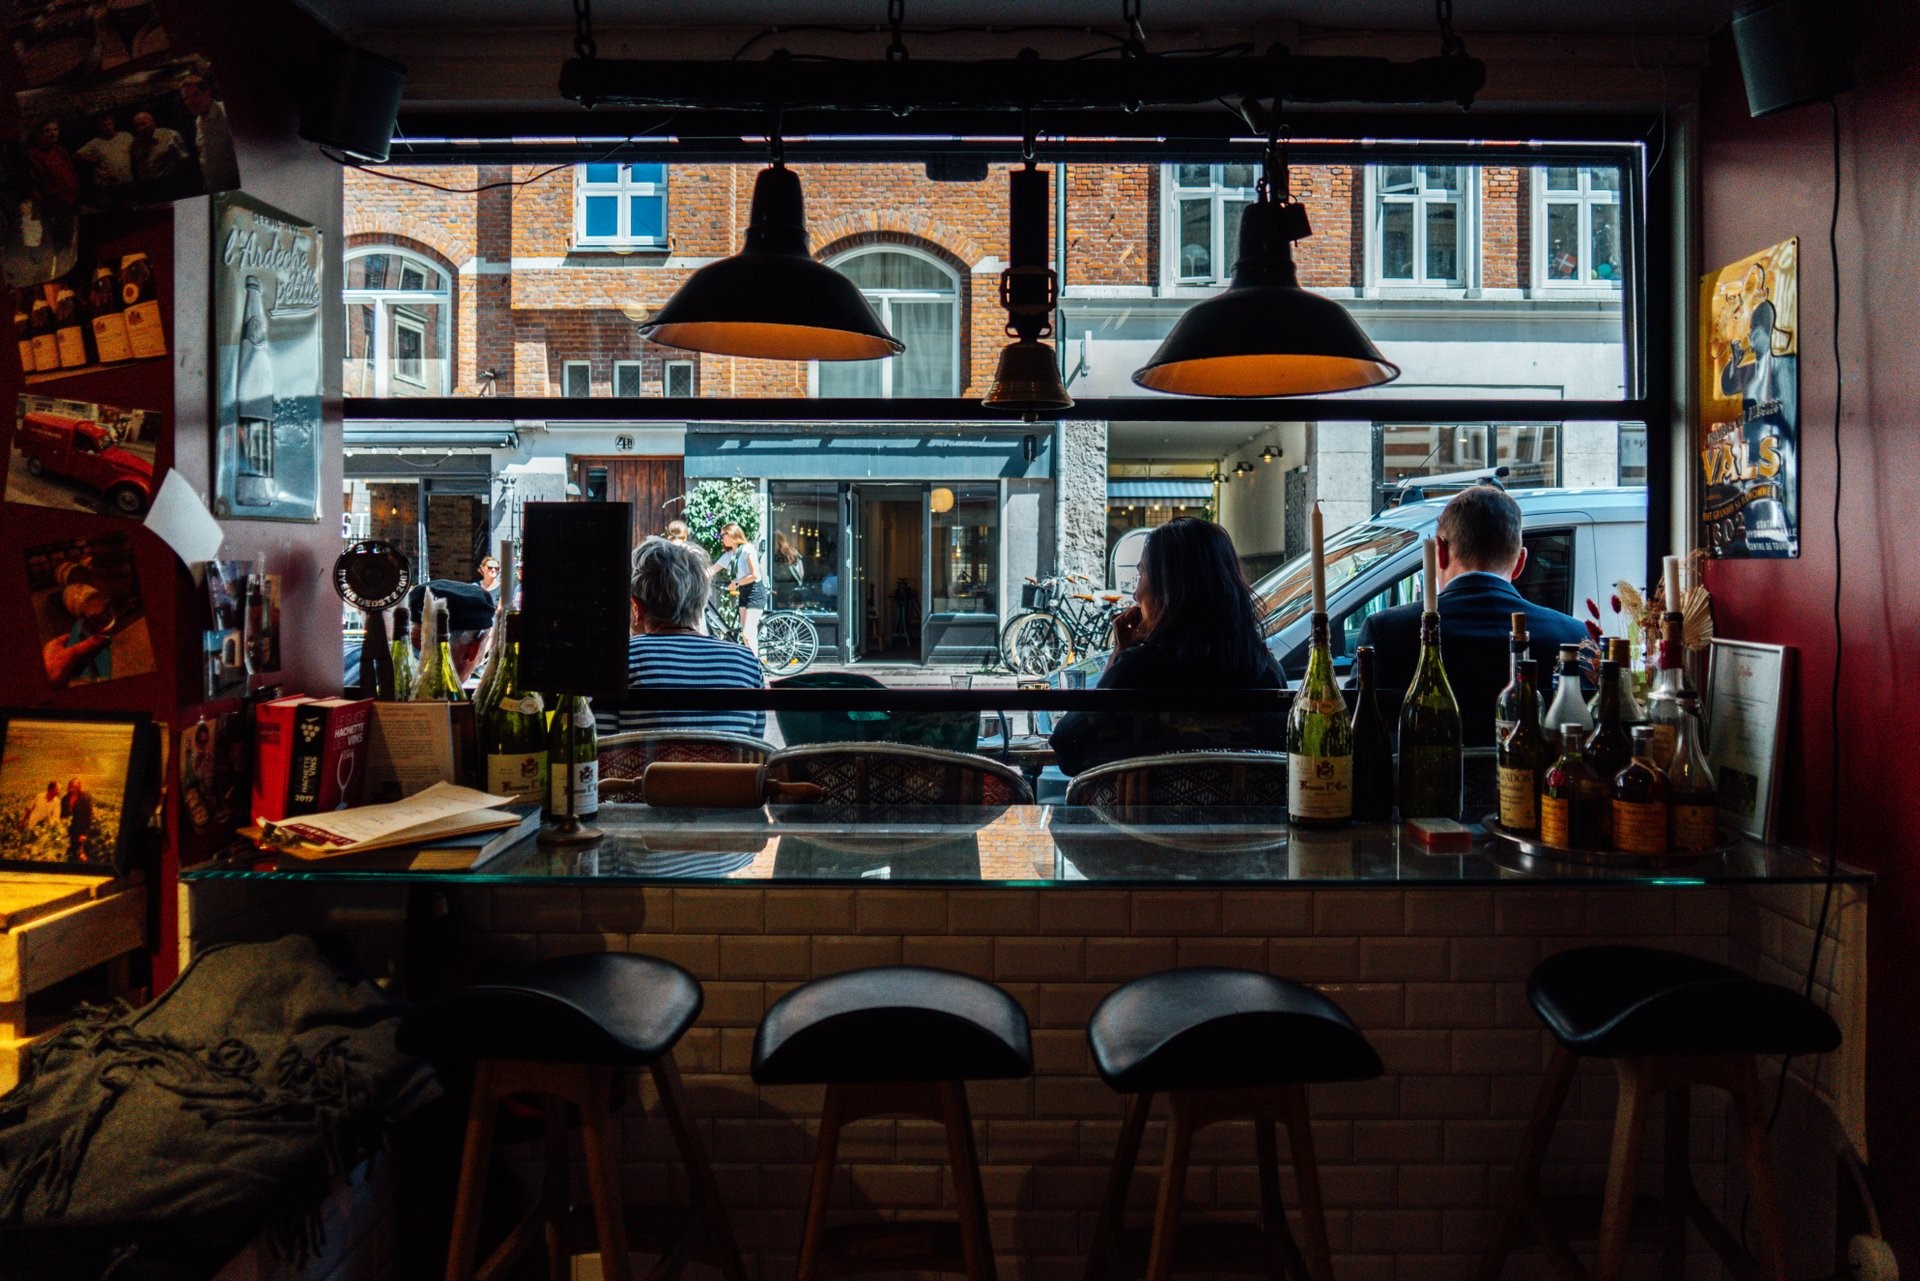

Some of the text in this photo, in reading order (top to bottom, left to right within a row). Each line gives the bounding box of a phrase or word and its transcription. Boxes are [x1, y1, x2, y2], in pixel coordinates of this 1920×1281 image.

[1701, 435, 1781, 486] VALS
[396, 569, 408, 593] 2007
[334, 722, 366, 740] HACHETTE
[294, 794, 314, 803] 2017
